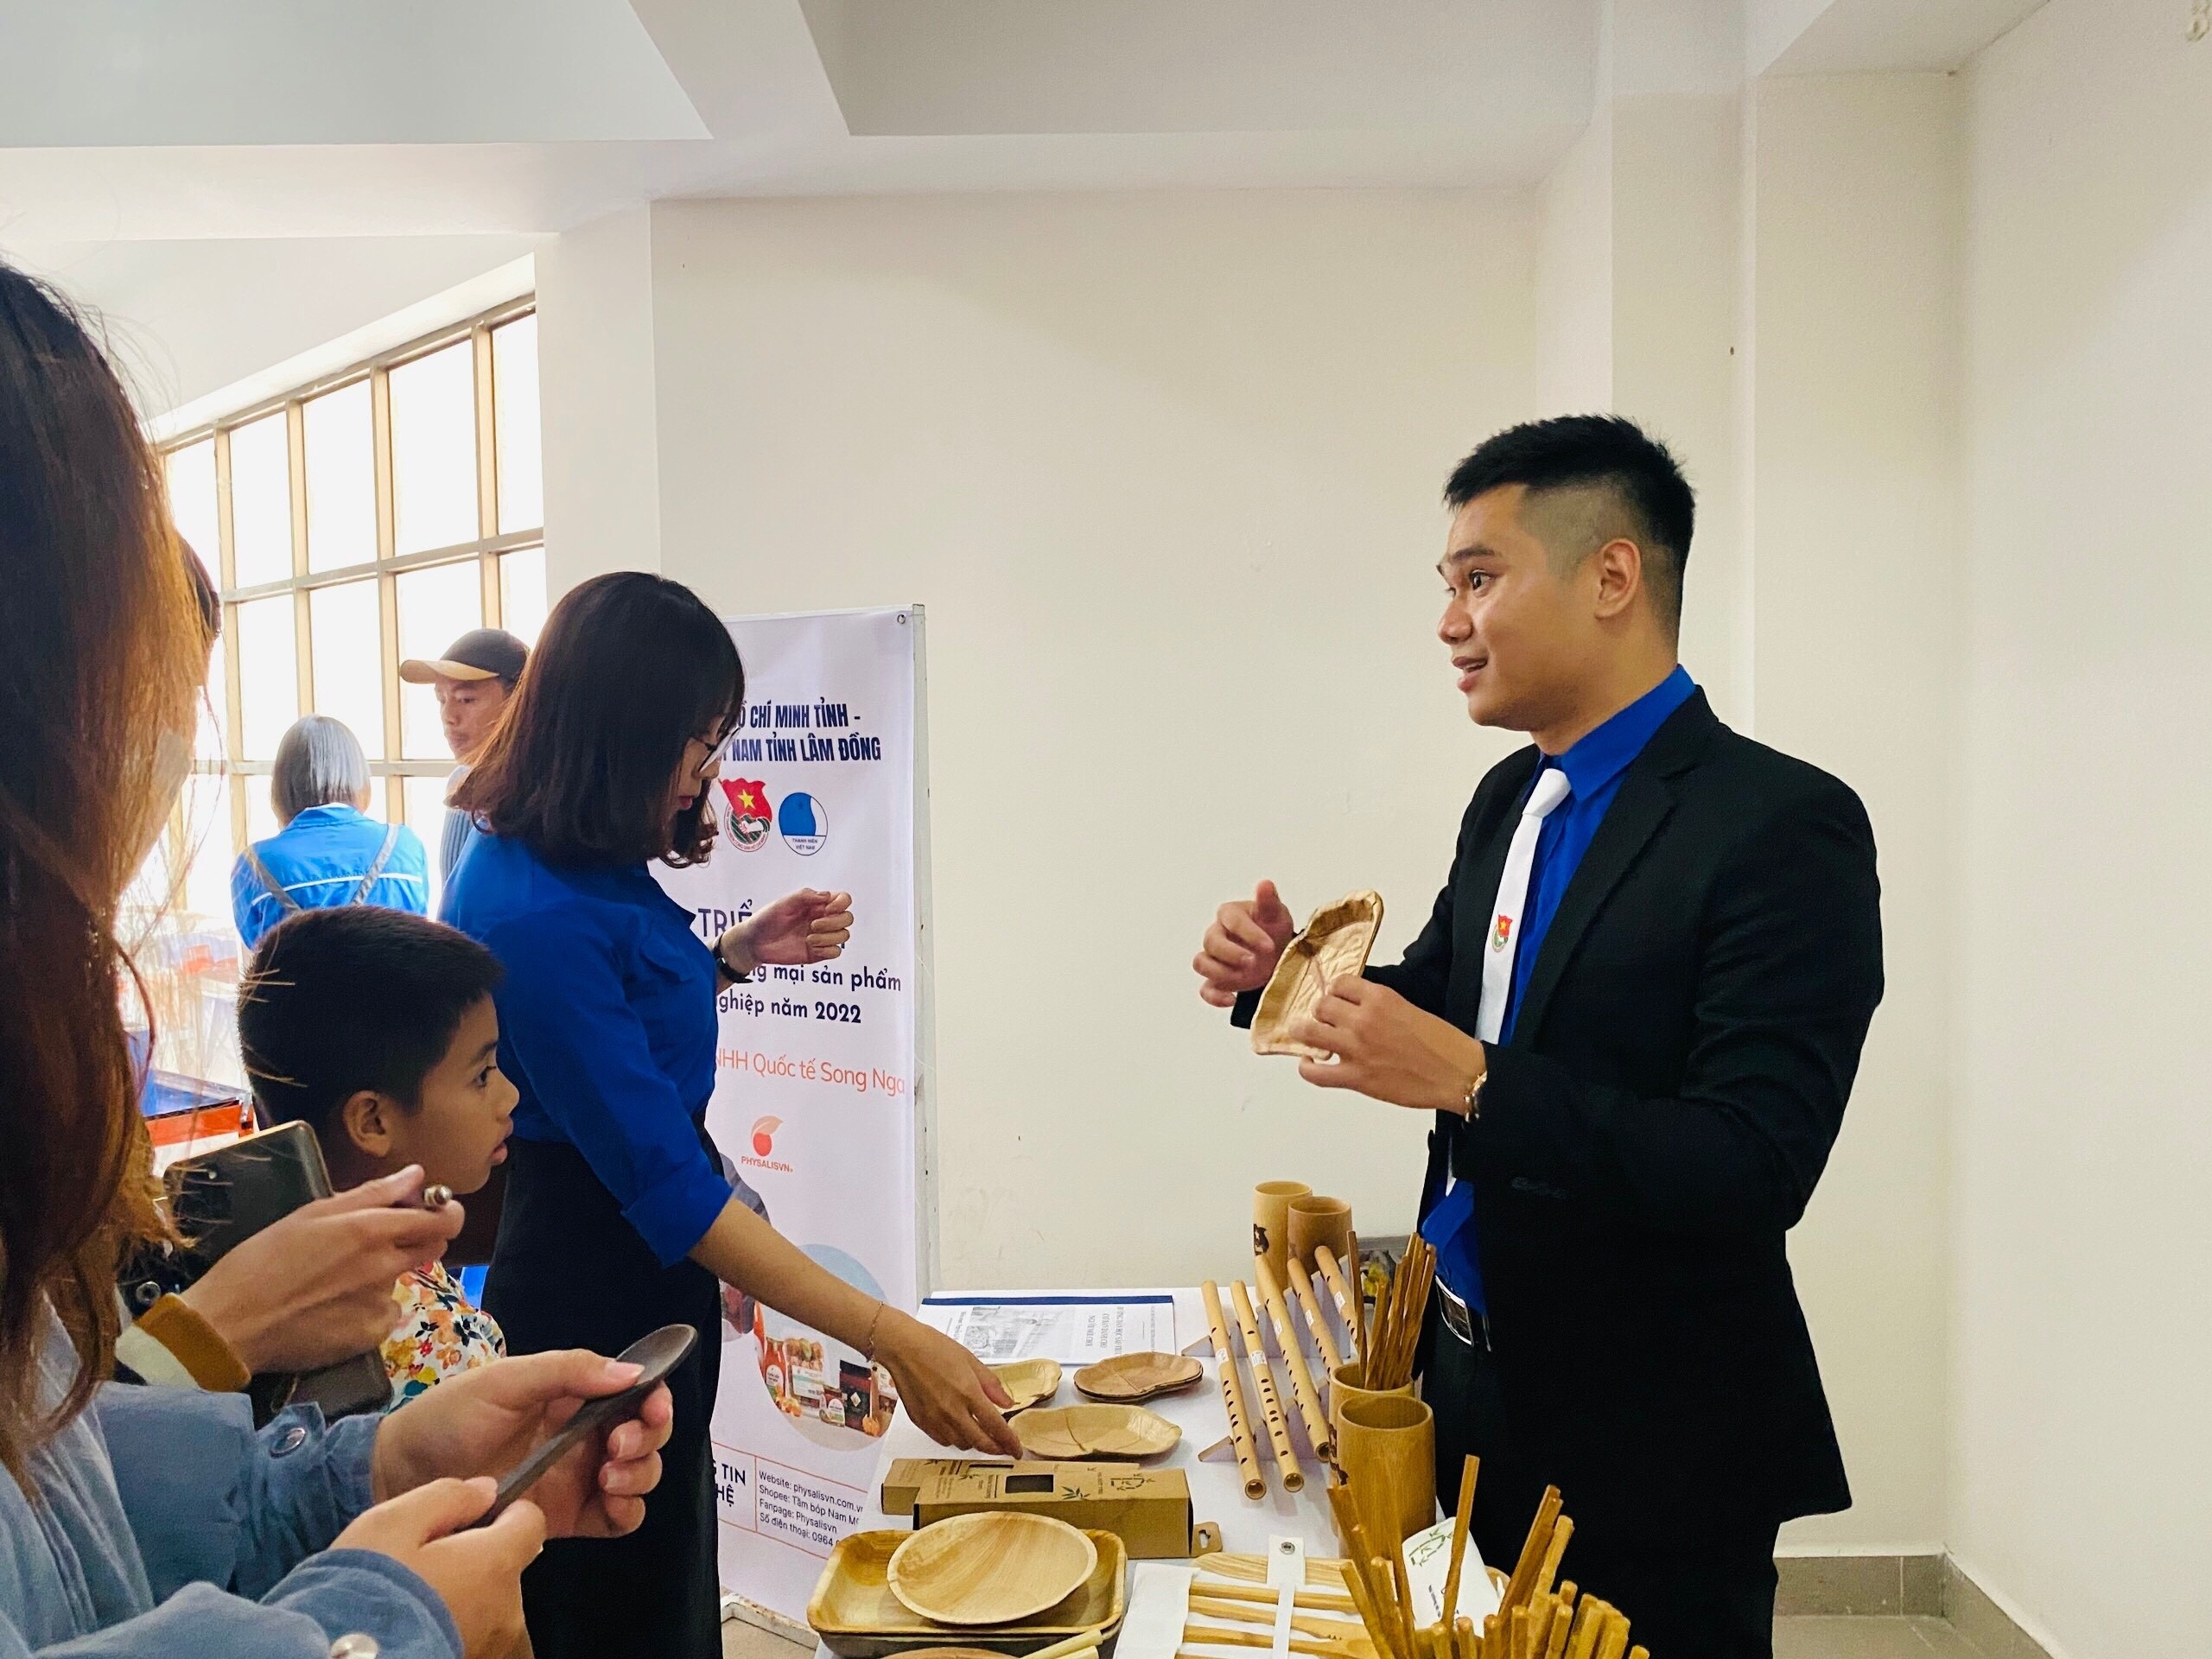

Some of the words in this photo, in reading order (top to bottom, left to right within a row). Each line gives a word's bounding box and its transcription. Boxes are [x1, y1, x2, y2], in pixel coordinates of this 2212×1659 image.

[739, 700, 747, 728] Ồ
[750, 699, 772, 728] CHÍ
[776, 704, 810, 728] MINH
[814, 696, 849, 728] TỈNH
[733, 739, 762, 762] NAM
[766, 731, 797, 762] TỈNH
[800, 732, 835, 762] LÂM
[838, 732, 881, 761] ĐỒNG
[698, 899, 753, 938] TRIỂ
[774, 964, 804, 985] mại
[811, 965, 843, 986] sản
[851, 966, 901, 992] phẩm
[719, 988, 765, 1018] ghiệp
[772, 997, 808, 1019] năm
[815, 1001, 861, 1024] 2022
[716, 1048, 748, 1071] NHH
[753, 1053, 796, 1077] Quốc
[799, 1058, 816, 1079] tế
[821, 1062, 867, 1092] Song
[873, 1067, 905, 1096] Nga
[721, 1463, 746, 1486] TIN
[760, 1471, 791, 1490] Website:
[759, 1484, 790, 1503] Shopee:
[810, 1503, 826, 1517] bóp
[828, 1508, 847, 1523] Nam
[760, 1498, 794, 1519] Fanpage:
[796, 1511, 837, 1535] Physalisvn
[760, 1512, 770, 1523] Số
[771, 1517, 788, 1530] điện
[811, 1532, 834, 1548] 0964
